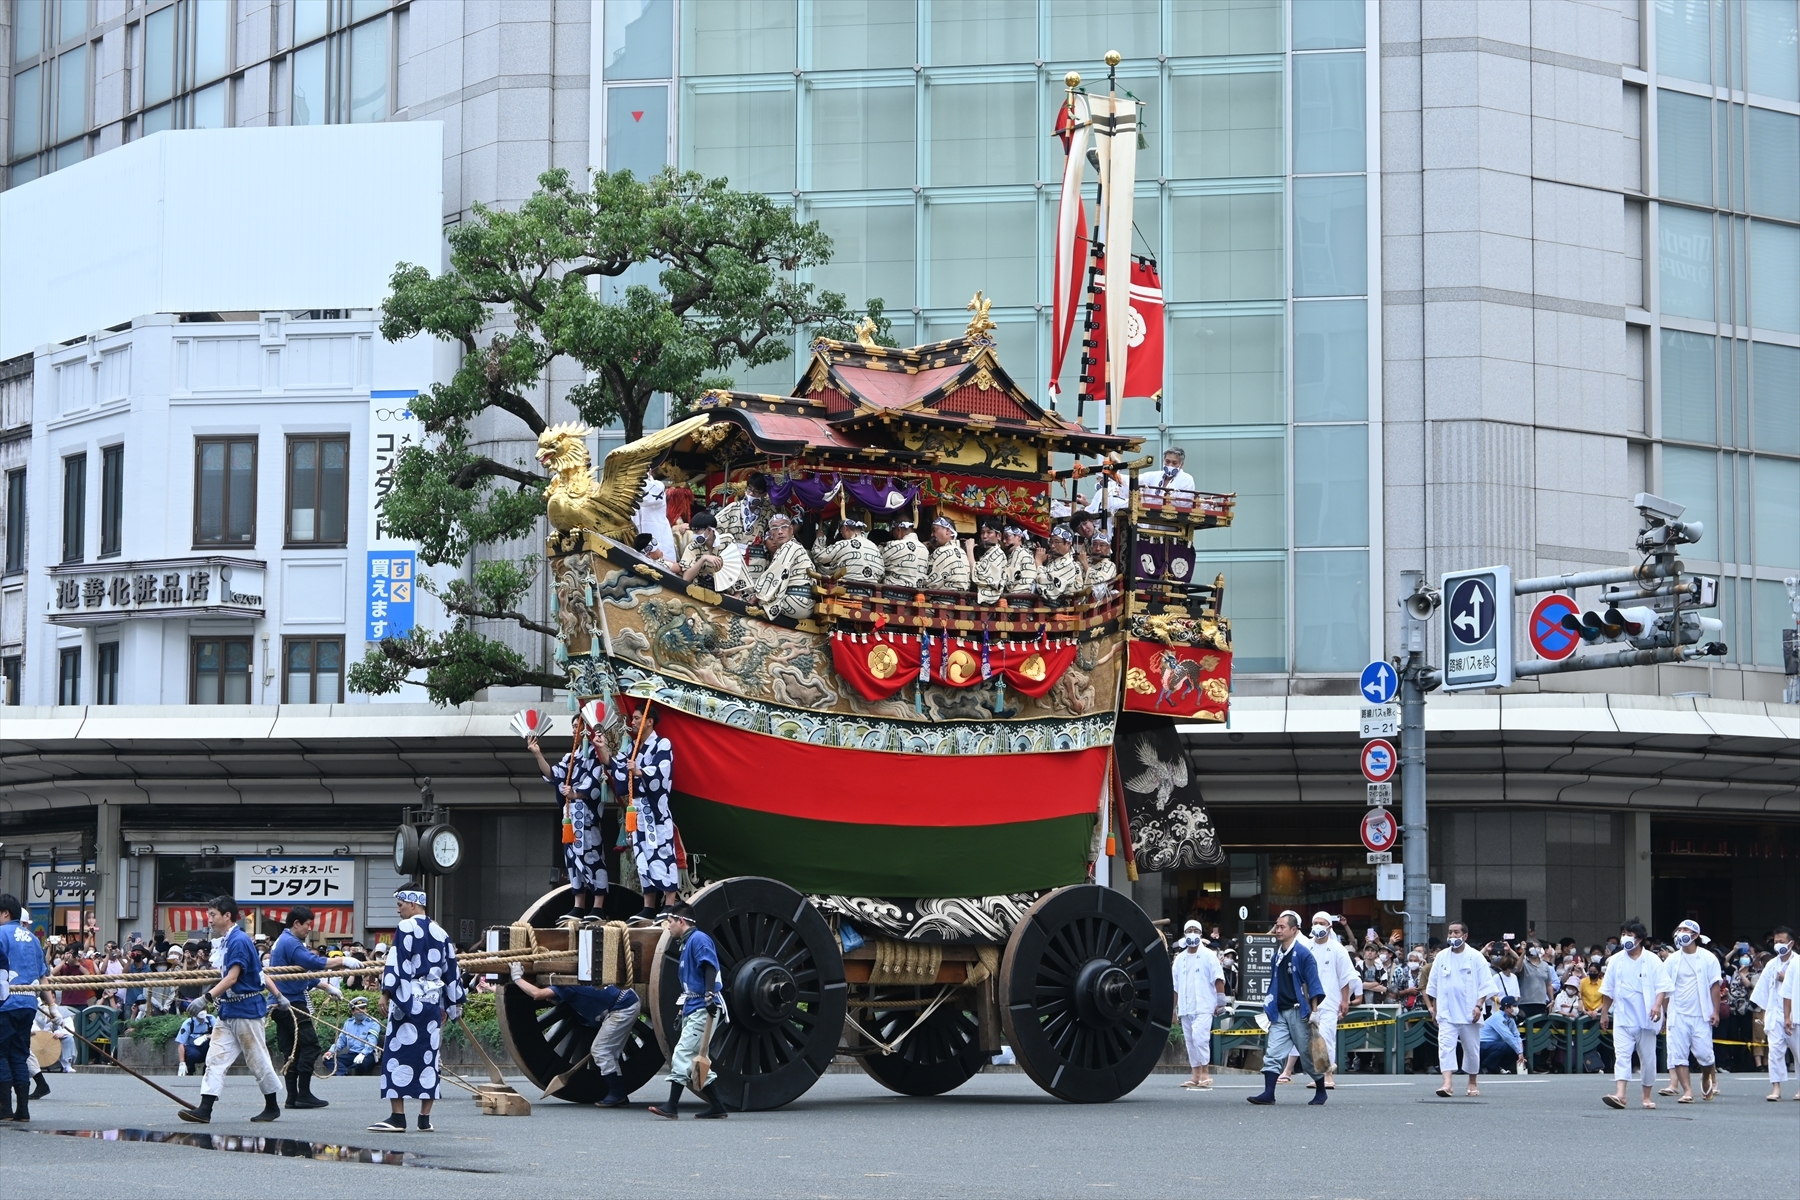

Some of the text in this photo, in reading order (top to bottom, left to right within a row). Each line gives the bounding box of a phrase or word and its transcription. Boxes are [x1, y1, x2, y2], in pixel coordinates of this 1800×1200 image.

[392, 560, 409, 601] すぐ
[56, 571, 210, 609] 池善化粧品店
[371, 559, 390, 639] 買えます
[1448, 655, 1496, 673] 路線バスを除く
[280, 864, 340, 874] メガネスーパー
[57, 880, 87, 888] コンタクト
[250, 879, 339, 896] コンタクト
